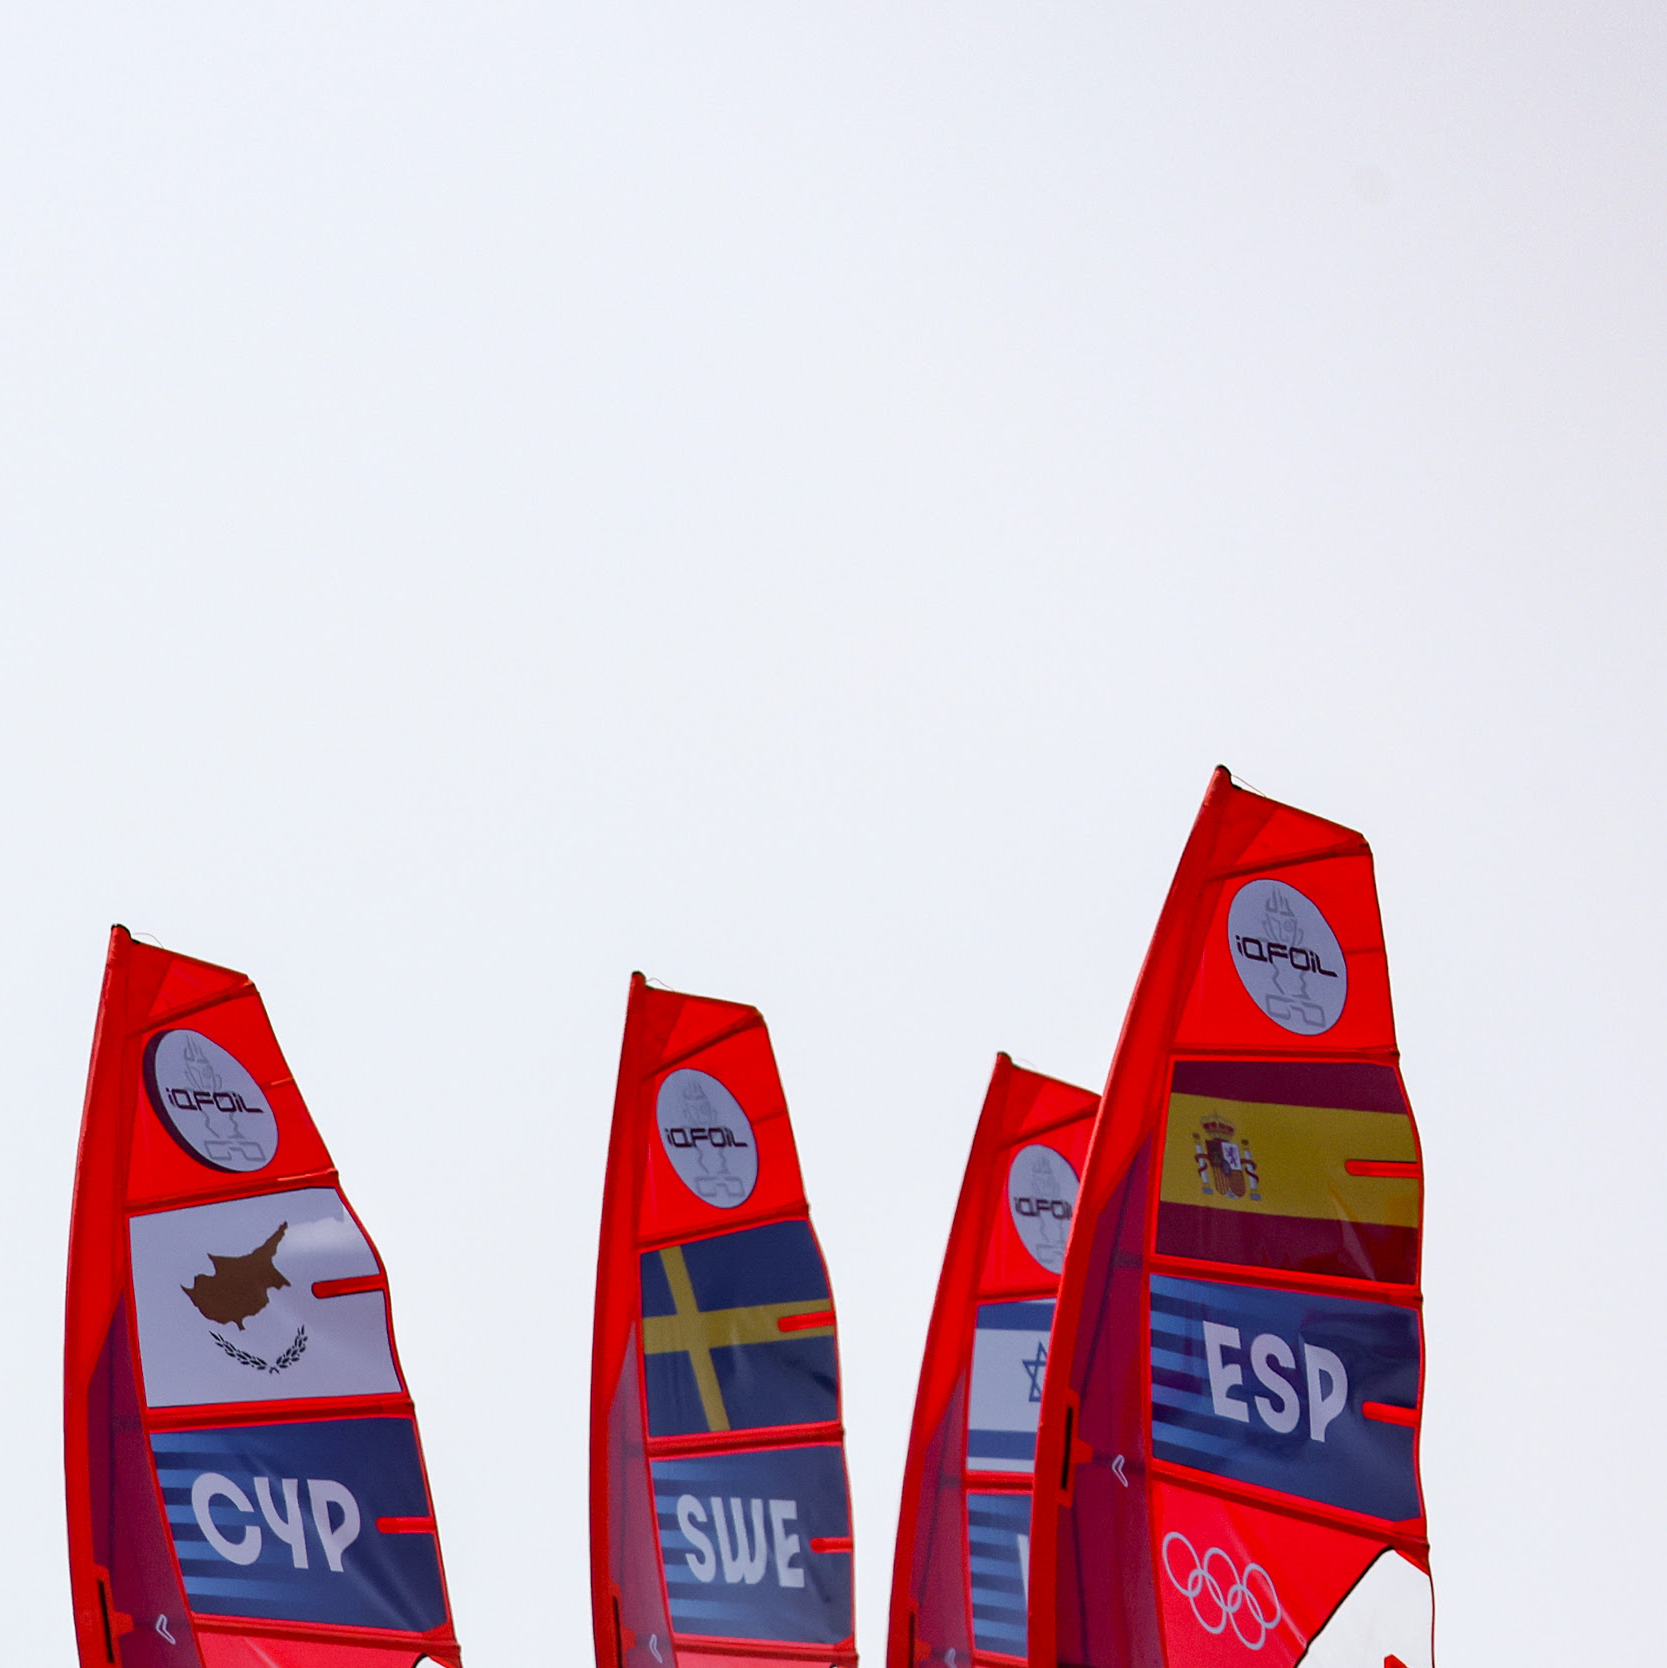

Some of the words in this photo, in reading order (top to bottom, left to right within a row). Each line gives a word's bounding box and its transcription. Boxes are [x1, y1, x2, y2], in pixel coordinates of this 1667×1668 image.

[1202, 1320, 1349, 1444] ESP
[190, 1471, 362, 1573] CYP
[676, 1493, 806, 1589] SWE
